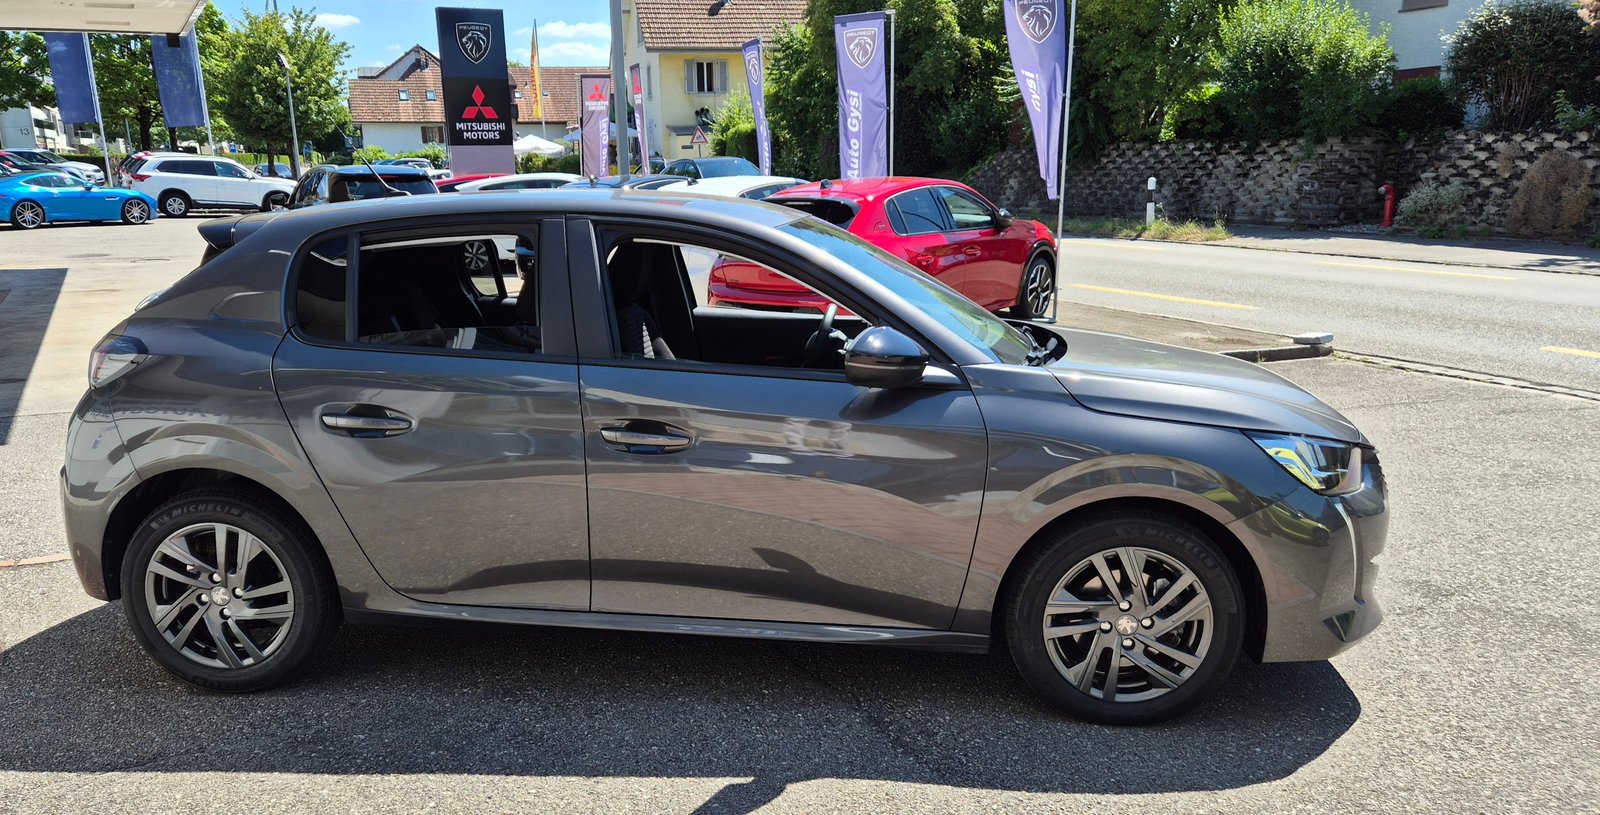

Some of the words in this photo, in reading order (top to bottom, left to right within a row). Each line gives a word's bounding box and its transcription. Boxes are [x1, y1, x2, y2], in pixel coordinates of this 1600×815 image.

[847, 88, 862, 133] Gysi
[19, 127, 30, 136] 13
[456, 122, 506, 131] MITSUBISHI
[463, 131, 500, 140] MOTORS
[848, 138, 860, 181] Auto
[172, 503, 241, 518] MICHELIN
[1145, 527, 1218, 570] MICHELIN
